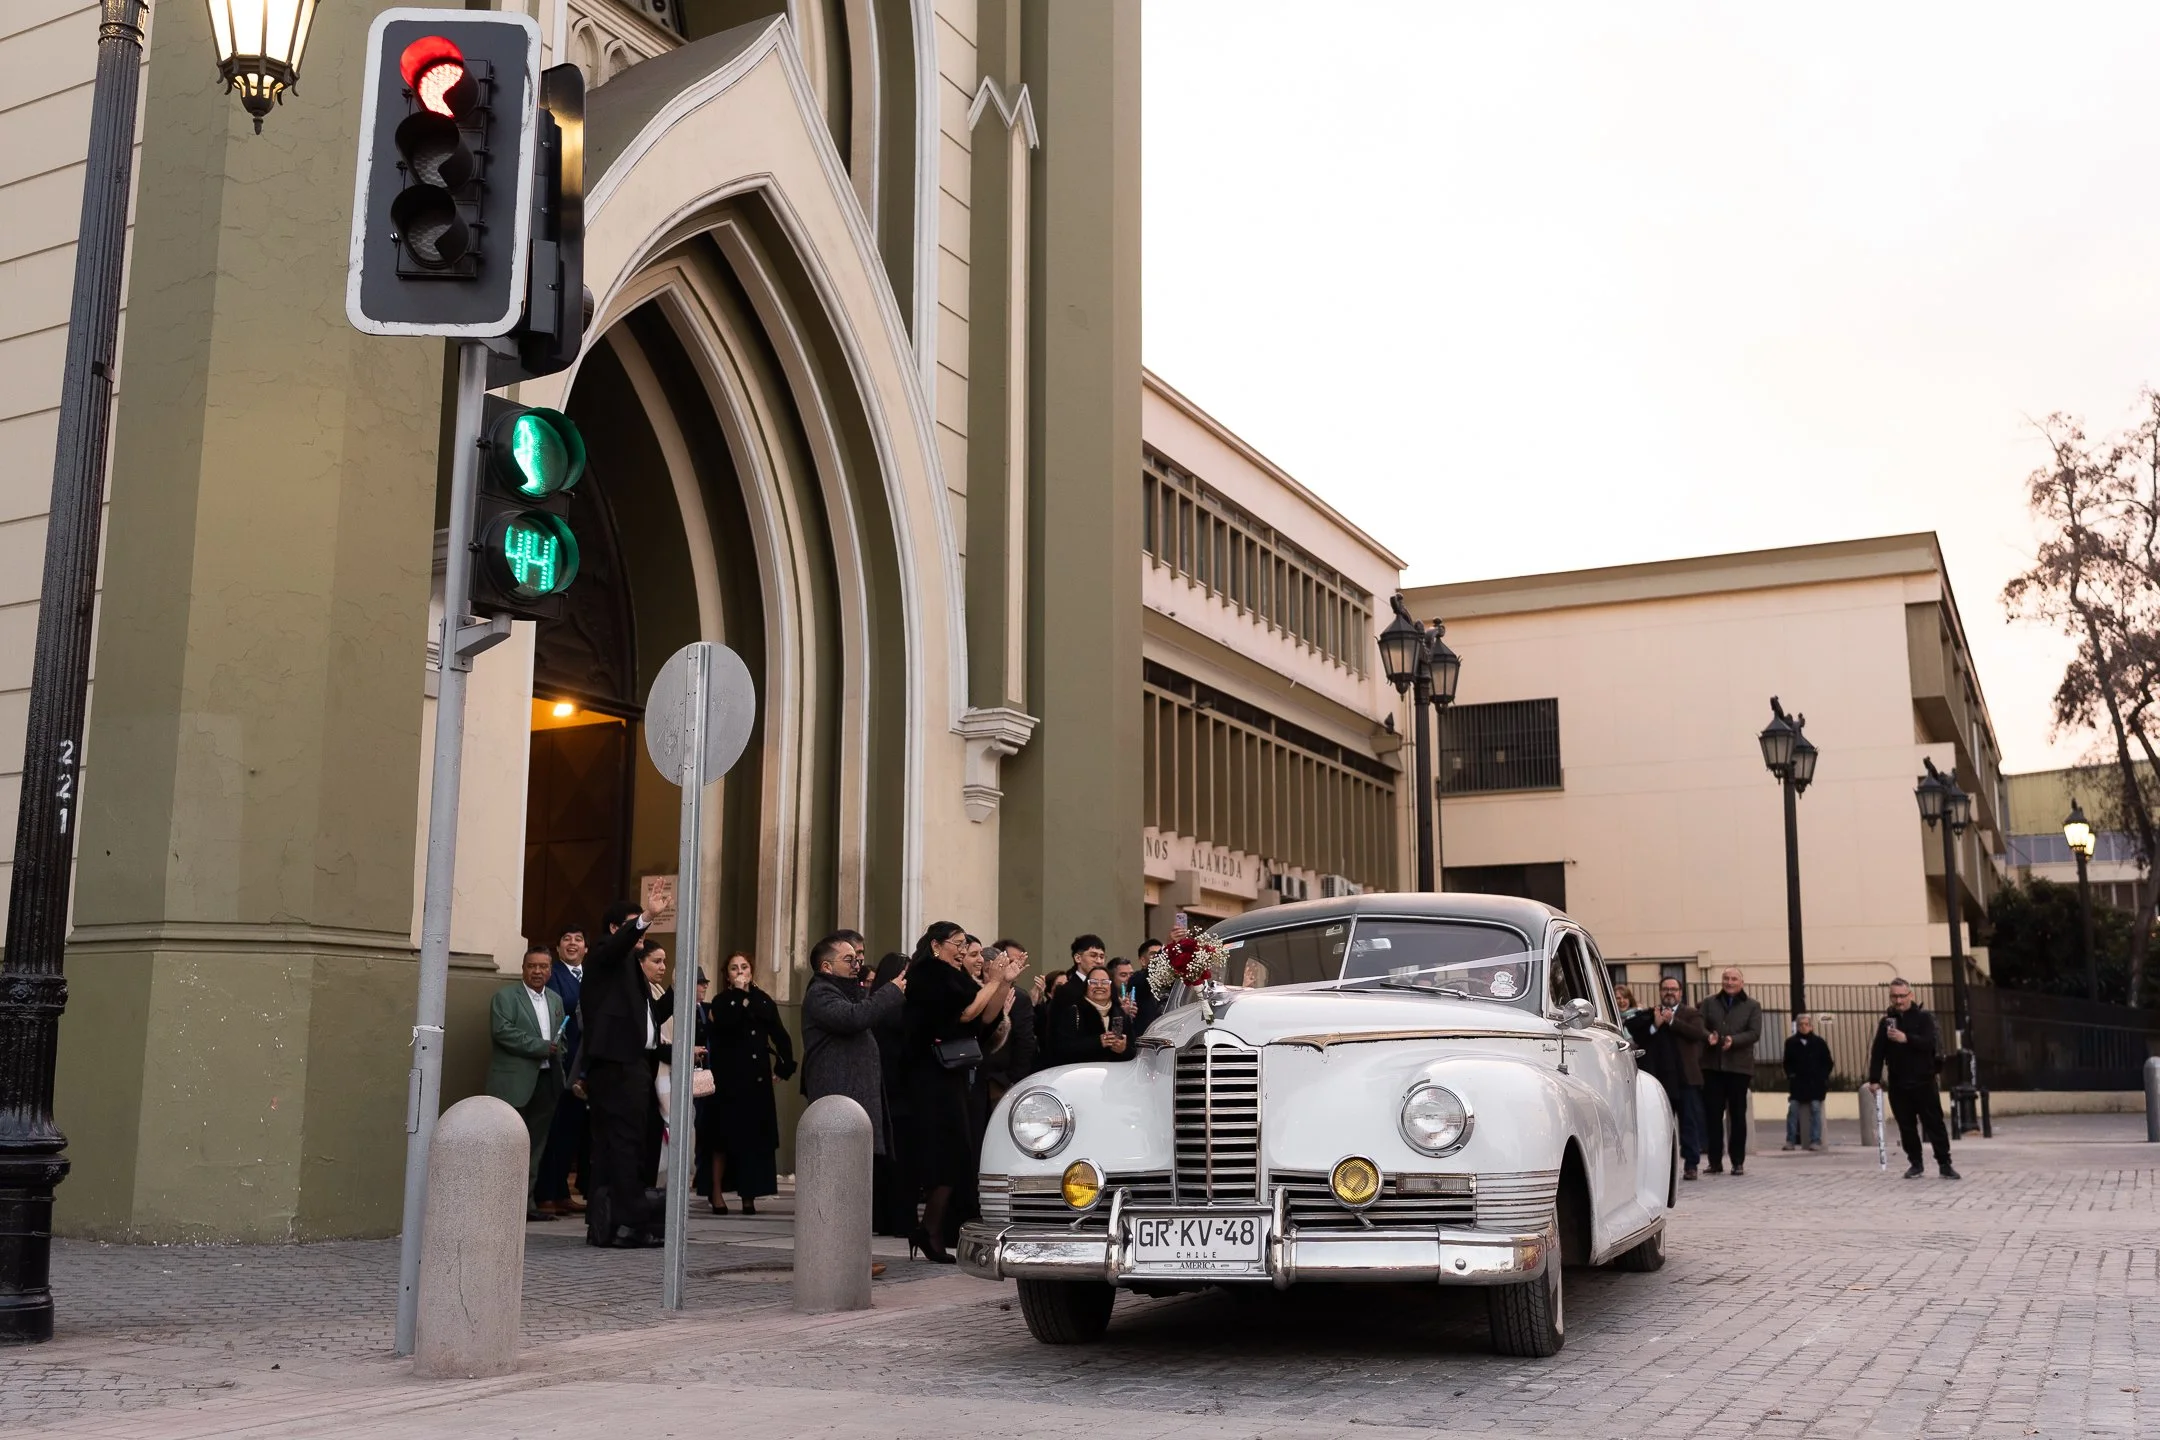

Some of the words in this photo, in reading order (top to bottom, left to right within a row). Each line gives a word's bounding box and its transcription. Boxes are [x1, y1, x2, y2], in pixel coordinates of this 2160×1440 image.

[505, 525, 558, 591] 44
[56, 739, 74, 834] 221
[1190, 847, 1243, 879] ALAMEDA
[1176, 1251, 1217, 1259] CHILE
[1179, 1262, 1216, 1270] AMERICA
